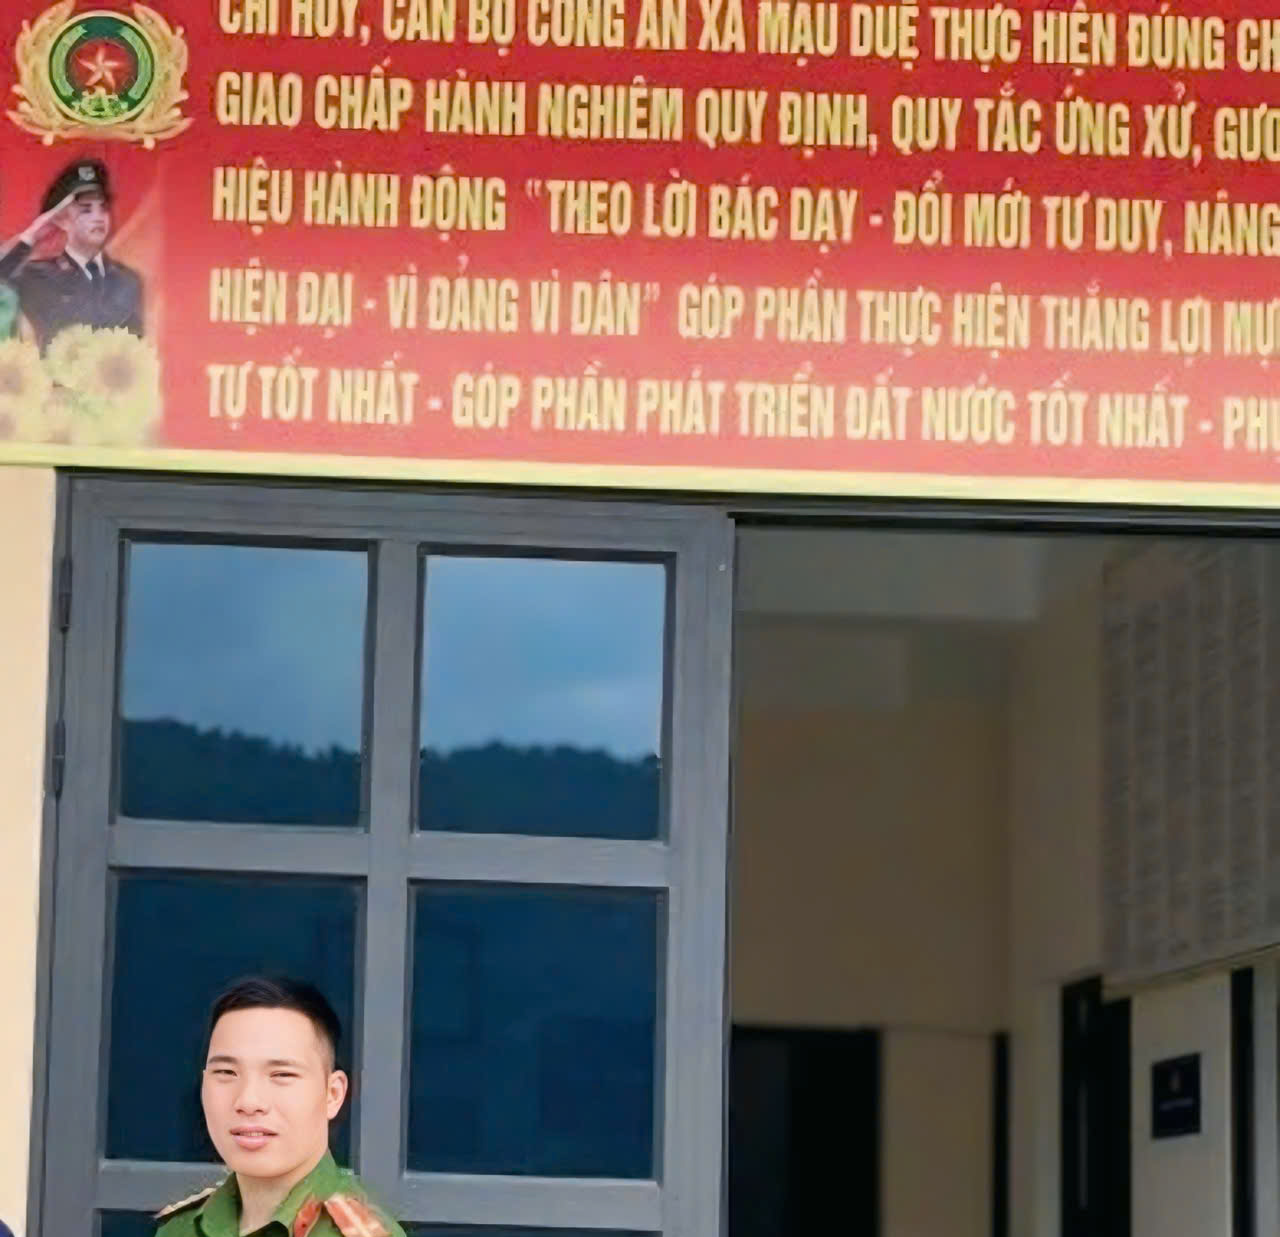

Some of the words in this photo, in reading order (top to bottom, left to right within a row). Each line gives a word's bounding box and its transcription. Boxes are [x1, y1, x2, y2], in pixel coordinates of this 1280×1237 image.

[930, 2, 1021, 72] THỰC
[1033, 0, 1117, 76] HIỆN
[1127, 2, 1225, 71] ĐÚNG
[216, 70, 303, 127] GIAO
[314, 57, 415, 132] CHẤP
[425, 68, 526, 136] HÀNH
[537, 75, 684, 141] NGHIÊM
[695, 88, 768, 149] QUY
[779, 91, 878, 158] ĐỊNH,
[892, 95, 963, 155] QUY
[974, 80, 1043, 155] TẮC
[1055, 84, 1130, 157] ỨNG
[1142, 81, 1202, 168] XỬ,
[212, 156, 293, 236] HIỆU
[304, 160, 400, 229] HÀNH
[410, 163, 507, 241] ĐỘNG
[643, 168, 697, 238] LỜI
[708, 173, 780, 241] BÁC
[790, 187, 858, 254] DẠY
[893, 170, 953, 246] ĐỔI
[963, 177, 1031, 248] MỚI
[1043, 190, 1090, 251] TƯ
[1095, 198, 1174, 260] DUY,
[209, 257, 288, 337] HIỆN
[297, 271, 354, 339] ĐẠI
[388, 262, 418, 330] VÌ
[428, 254, 519, 333] ĐẢNG
[530, 268, 561, 335] VÌ
[677, 273, 744, 340] GÓP
[754, 268, 847, 343] PHẦN
[856, 285, 942, 357] THỰC
[952, 281, 1030, 358] HIỆN
[1039, 279, 1151, 351] THẮNG
[1161, 296, 1212, 367] LỢI
[206, 359, 254, 431] TỰ
[259, 346, 319, 421] TỐT
[328, 352, 420, 425] NHẤT
[452, 361, 522, 429] GÓP
[531, 360, 627, 431] PHẦN
[636, 366, 726, 434] PHÁT
[736, 360, 835, 439] TRIỂN
[846, 367, 913, 440] ĐẤT
[921, 372, 1016, 442] NƯỚC
[1027, 371, 1089, 446] TỐT
[1097, 374, 1189, 449] NHẤT
